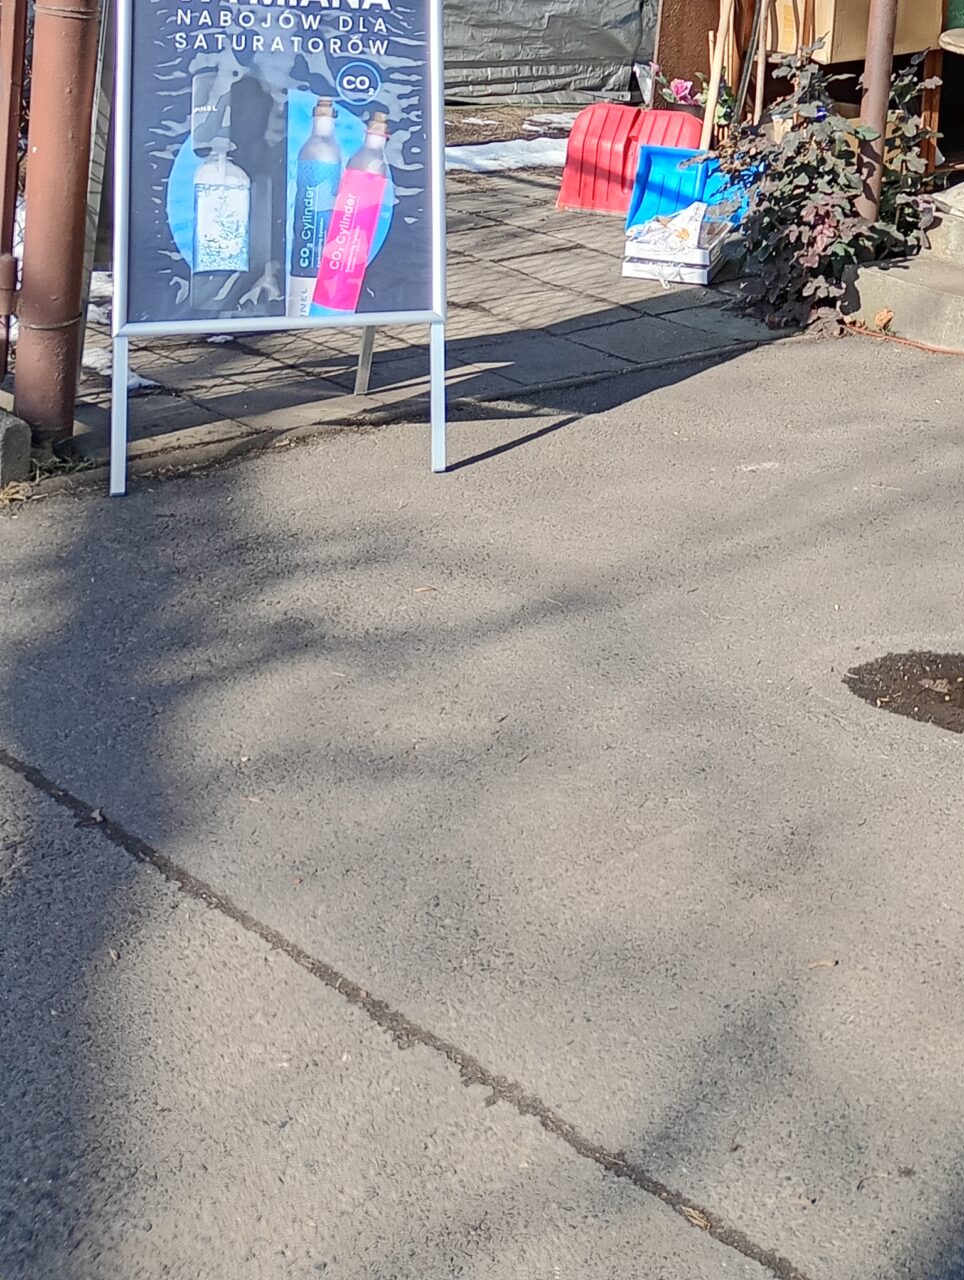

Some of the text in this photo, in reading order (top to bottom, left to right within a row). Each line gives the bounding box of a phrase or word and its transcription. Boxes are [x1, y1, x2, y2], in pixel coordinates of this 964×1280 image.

[176, 8, 388, 33] NABOJÓW DLA
[174, 32, 388, 56] SATURATORÓW
[302, 185, 314, 240] Cylinder
[337, 193, 357, 244] Cylinder
